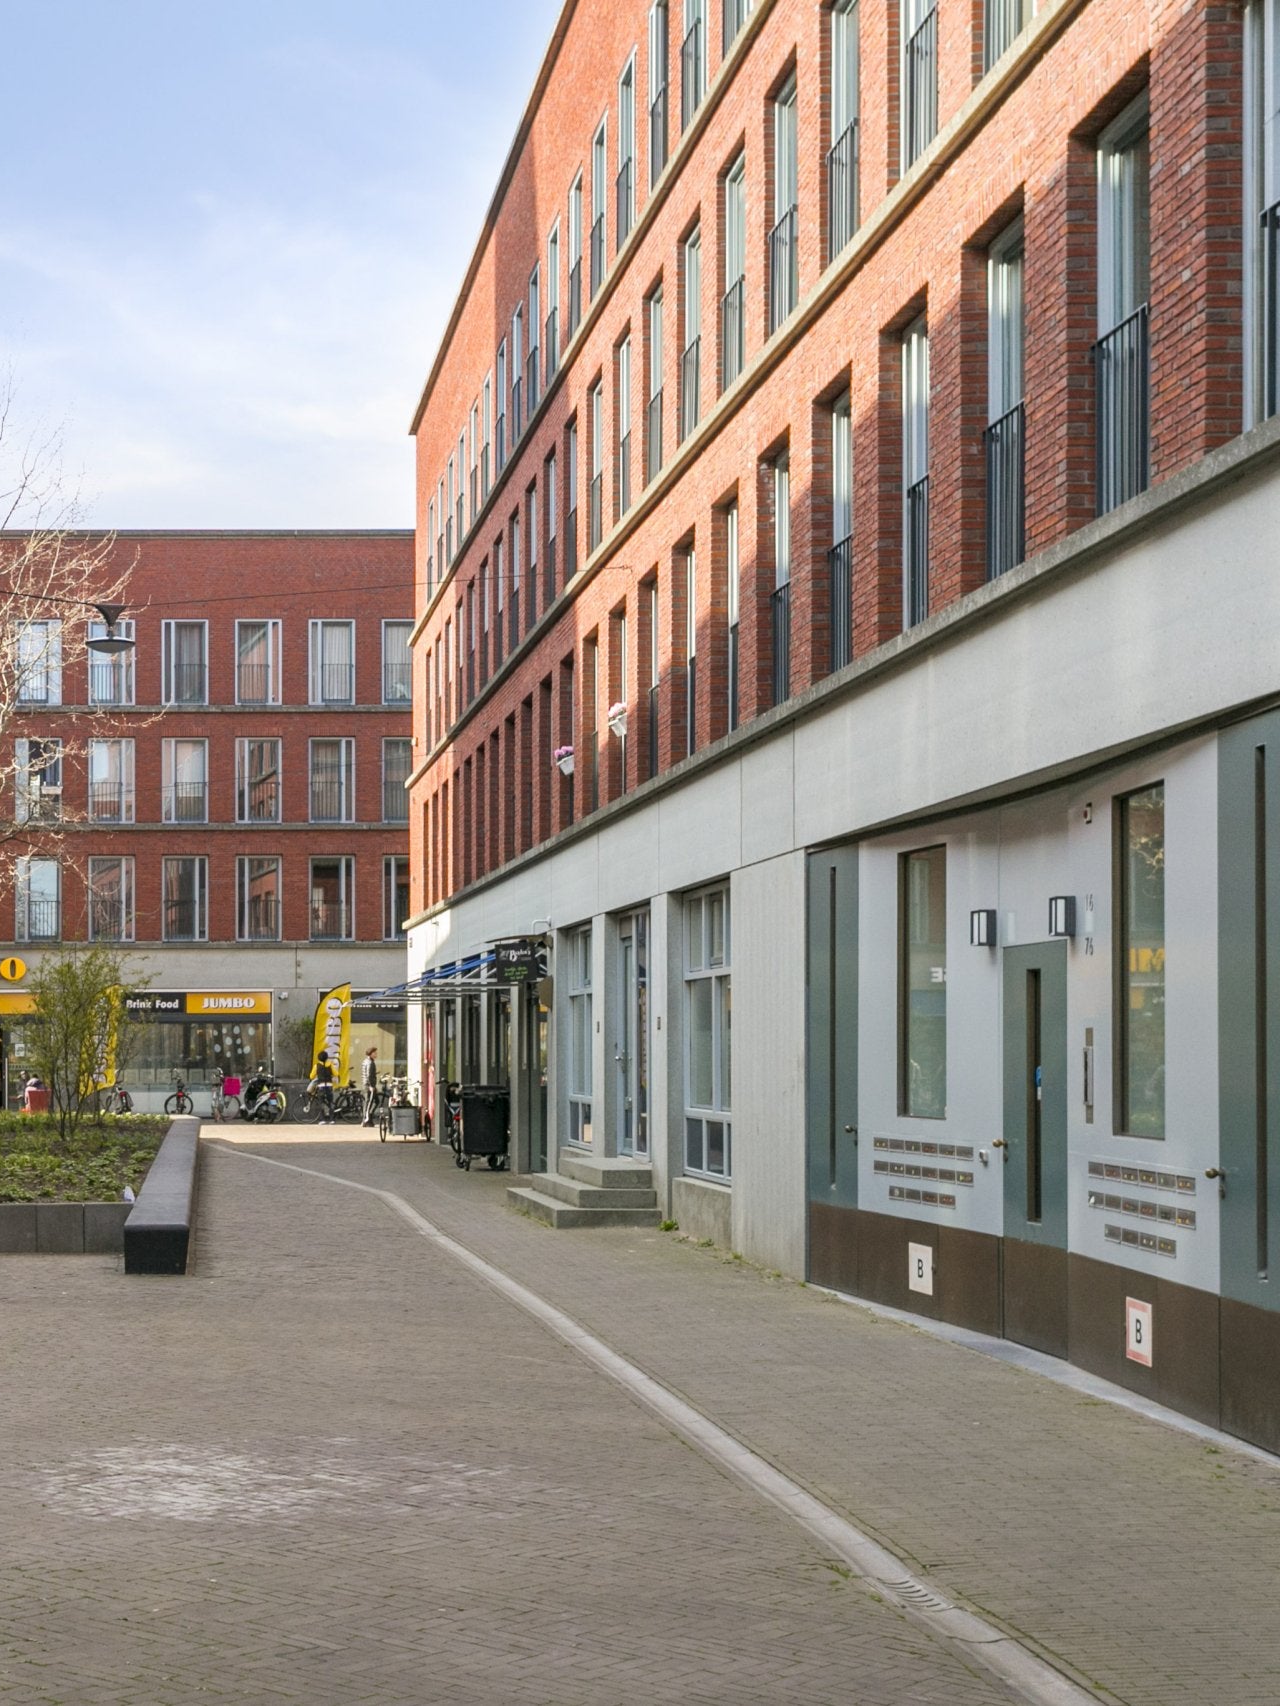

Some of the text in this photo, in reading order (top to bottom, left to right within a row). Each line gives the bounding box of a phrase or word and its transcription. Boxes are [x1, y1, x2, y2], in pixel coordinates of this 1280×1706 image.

[155, 1000, 179, 1009] Food
[202, 998, 255, 1009] JUMBO
[917, 1258, 924, 1279] B
[1135, 1318, 1142, 1344] B
